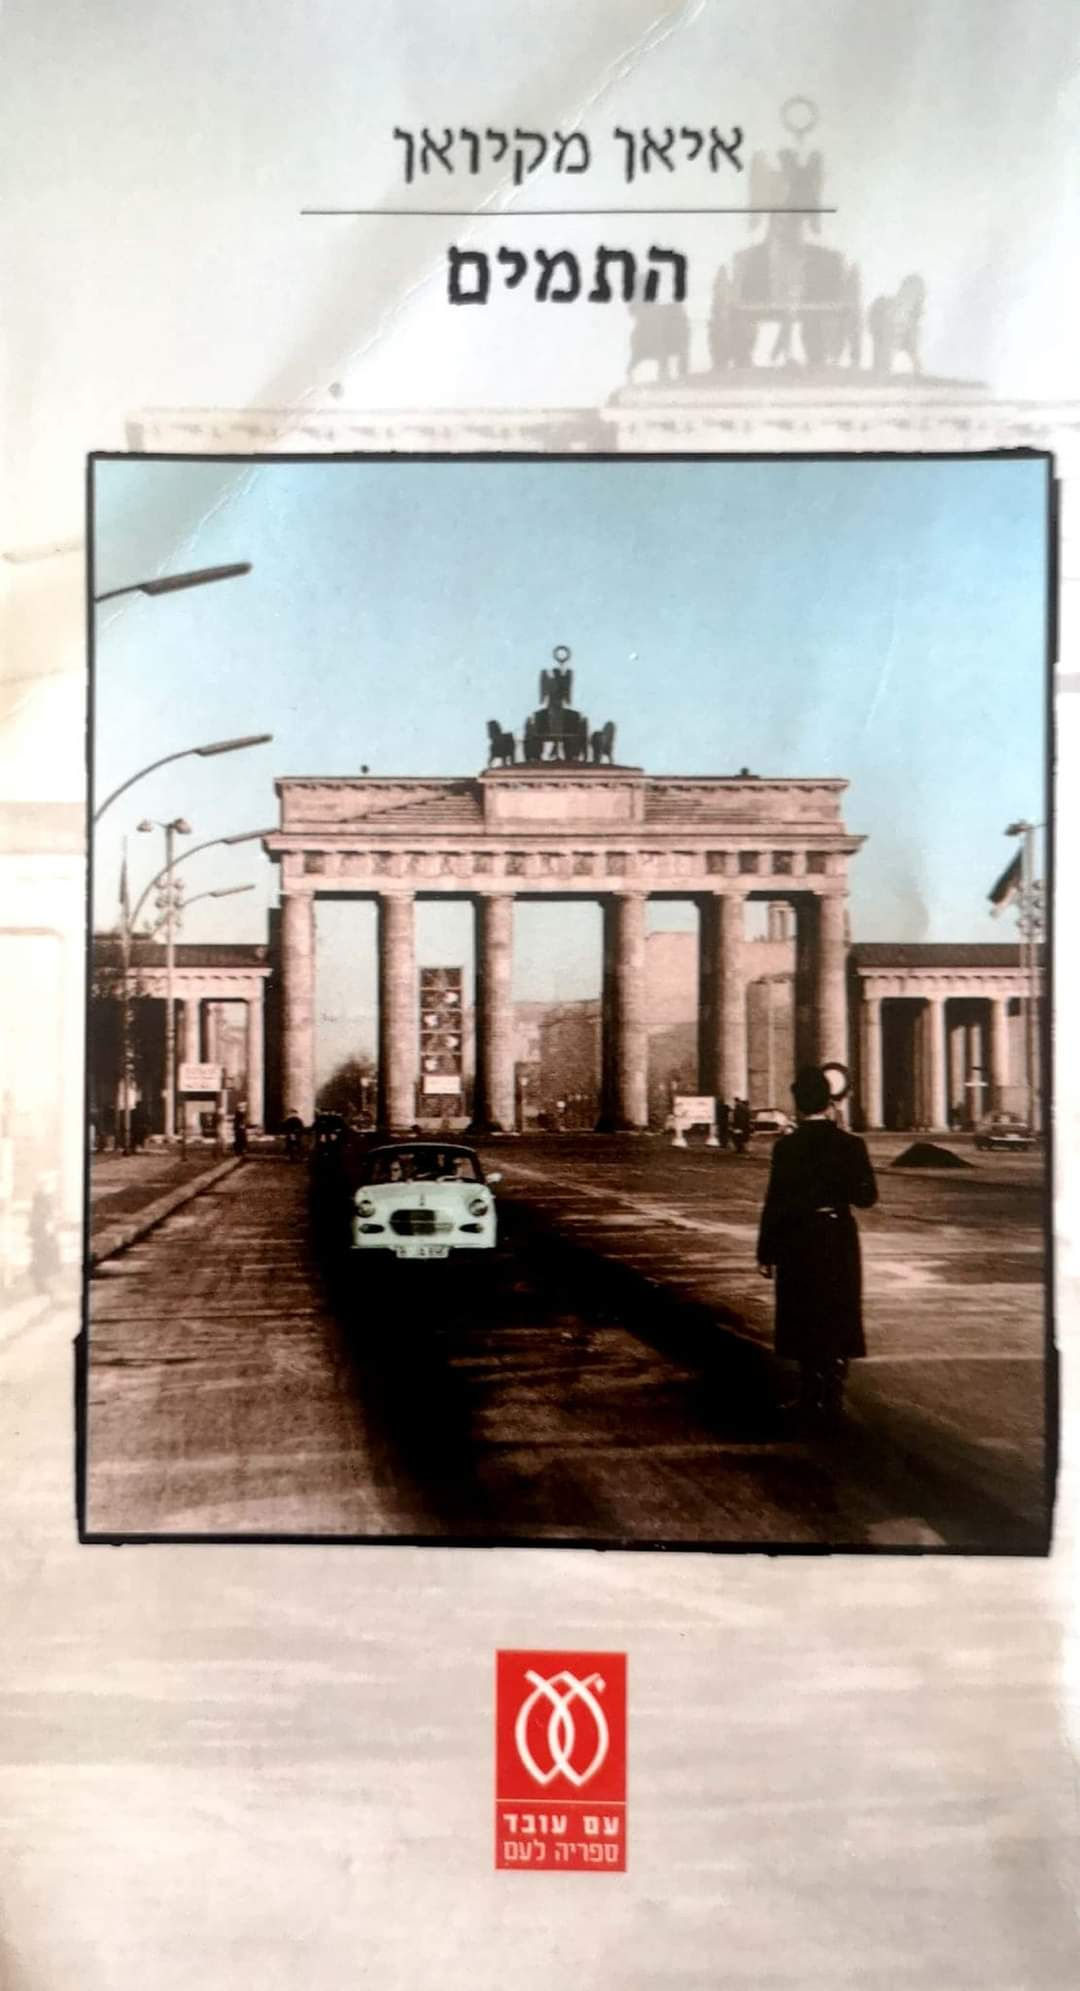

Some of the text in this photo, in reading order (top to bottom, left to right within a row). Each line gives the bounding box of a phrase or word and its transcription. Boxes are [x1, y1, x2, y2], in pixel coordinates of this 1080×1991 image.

[393, 126, 745, 185] איאן מקיואן
[447, 242, 689, 305] התמים
[503, 1813, 620, 1836] עם עובד
[503, 1839, 619, 1863] ספריה לעם
